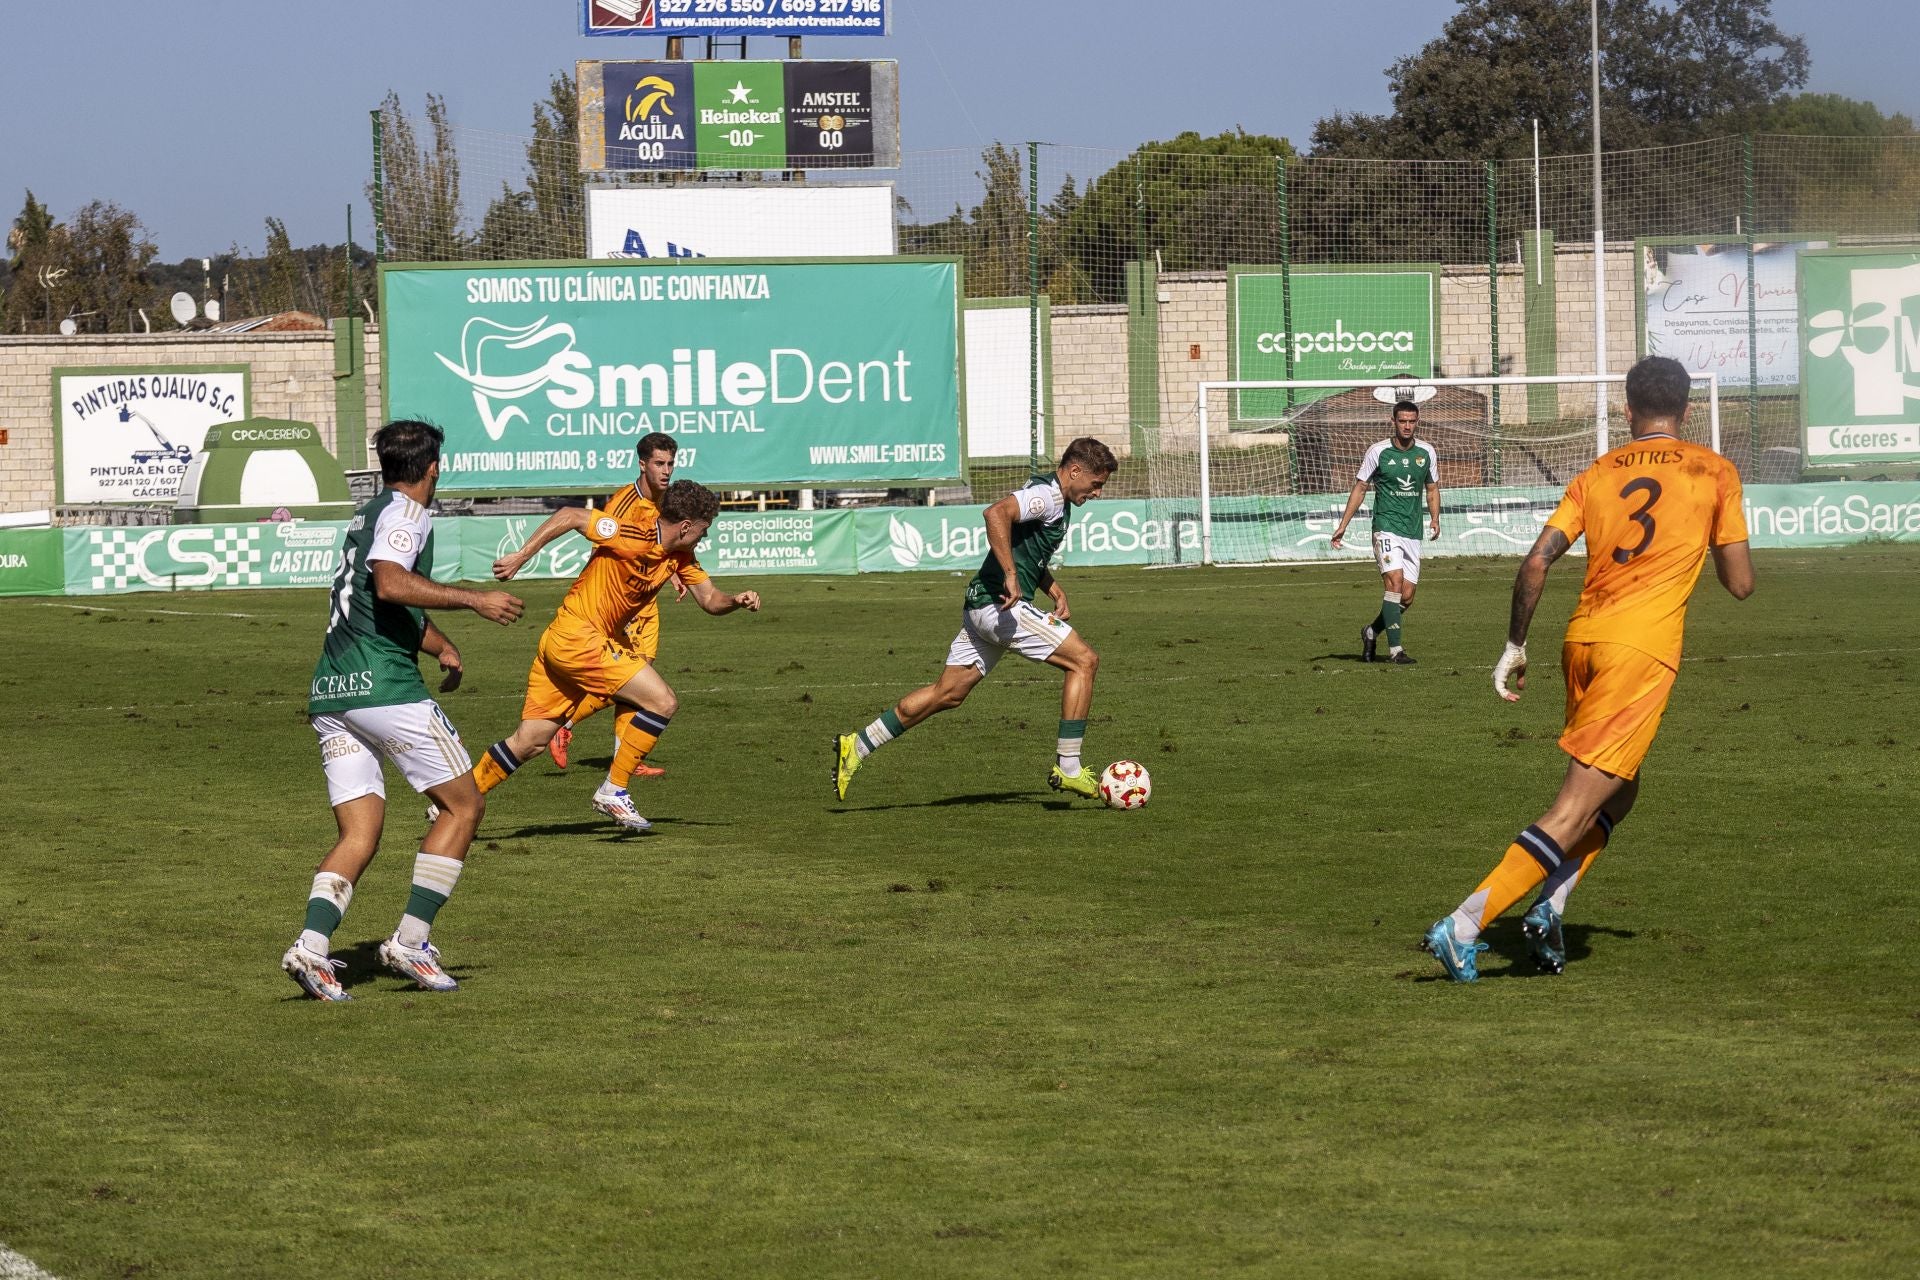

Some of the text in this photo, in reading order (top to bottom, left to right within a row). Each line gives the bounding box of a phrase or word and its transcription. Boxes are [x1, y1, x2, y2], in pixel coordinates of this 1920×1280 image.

[659, 0, 690, 12] 927
[695, 0, 727, 12] 276
[731, 0, 764, 12] 550
[782, 0, 812, 12] 609
[820, 0, 846, 12] 217
[852, 0, 880, 12] 916
[660, 15, 880, 28] www.marmolespedrotrenado.es
[803, 92, 860, 105] AMSTEL
[650, 115, 662, 123] EL
[701, 109, 781, 124] Heineken
[619, 122, 684, 140] ÁGUILA
[730, 130, 753, 147] 0.0
[819, 131, 843, 150] 0,0
[638, 142, 664, 163] 0,0
[467, 271, 770, 303] SOMOS TU CLÍNICA DE CONFIANZA
[1718, 273, 1797, 308] Murie
[1664, 319, 1711, 328] Desayunos,
[1712, 318, 1749, 327] Comidas
[1674, 328, 1727, 336] Comuniones,
[1729, 327, 1774, 335] Banetes,
[1338, 358, 1412, 374] Bodega familiar
[72, 376, 235, 421] PINTURAS OJALVO S.C.
[547, 410, 764, 436] CLINICA DENTAL
[1829, 427, 1898, 449] Cáceres
[438, 453, 450, 472] A
[452, 452, 513, 472] ANTONIO
[516, 450, 584, 473] HURTADO,
[586, 450, 596, 470] 8
[607, 449, 634, 469] 927
[809, 443, 946, 465] WWW.SMILE-DENT.ES
[1612, 448, 1684, 469] SOTRES
[90, 465, 143, 476] PINTURA
[148, 465, 164, 475] EN
[99, 478, 115, 487] 927
[118, 478, 133, 486] 241
[135, 477, 151, 486] 120
[1611, 476, 1663, 565] 3
[1745, 494, 1920, 536] ineríaSara
[717, 517, 813, 531] especialidad
[718, 529, 813, 545] a la plancha
[718, 546, 815, 559] PLAZA MAYOR, 6
[1379, 538, 1392, 553] 15
[269, 549, 334, 573] CASTRO
[718, 558, 818, 568] JUNTO AL ARCO DE LA ESTRELLA
[385, 742, 414, 756] EDIO
